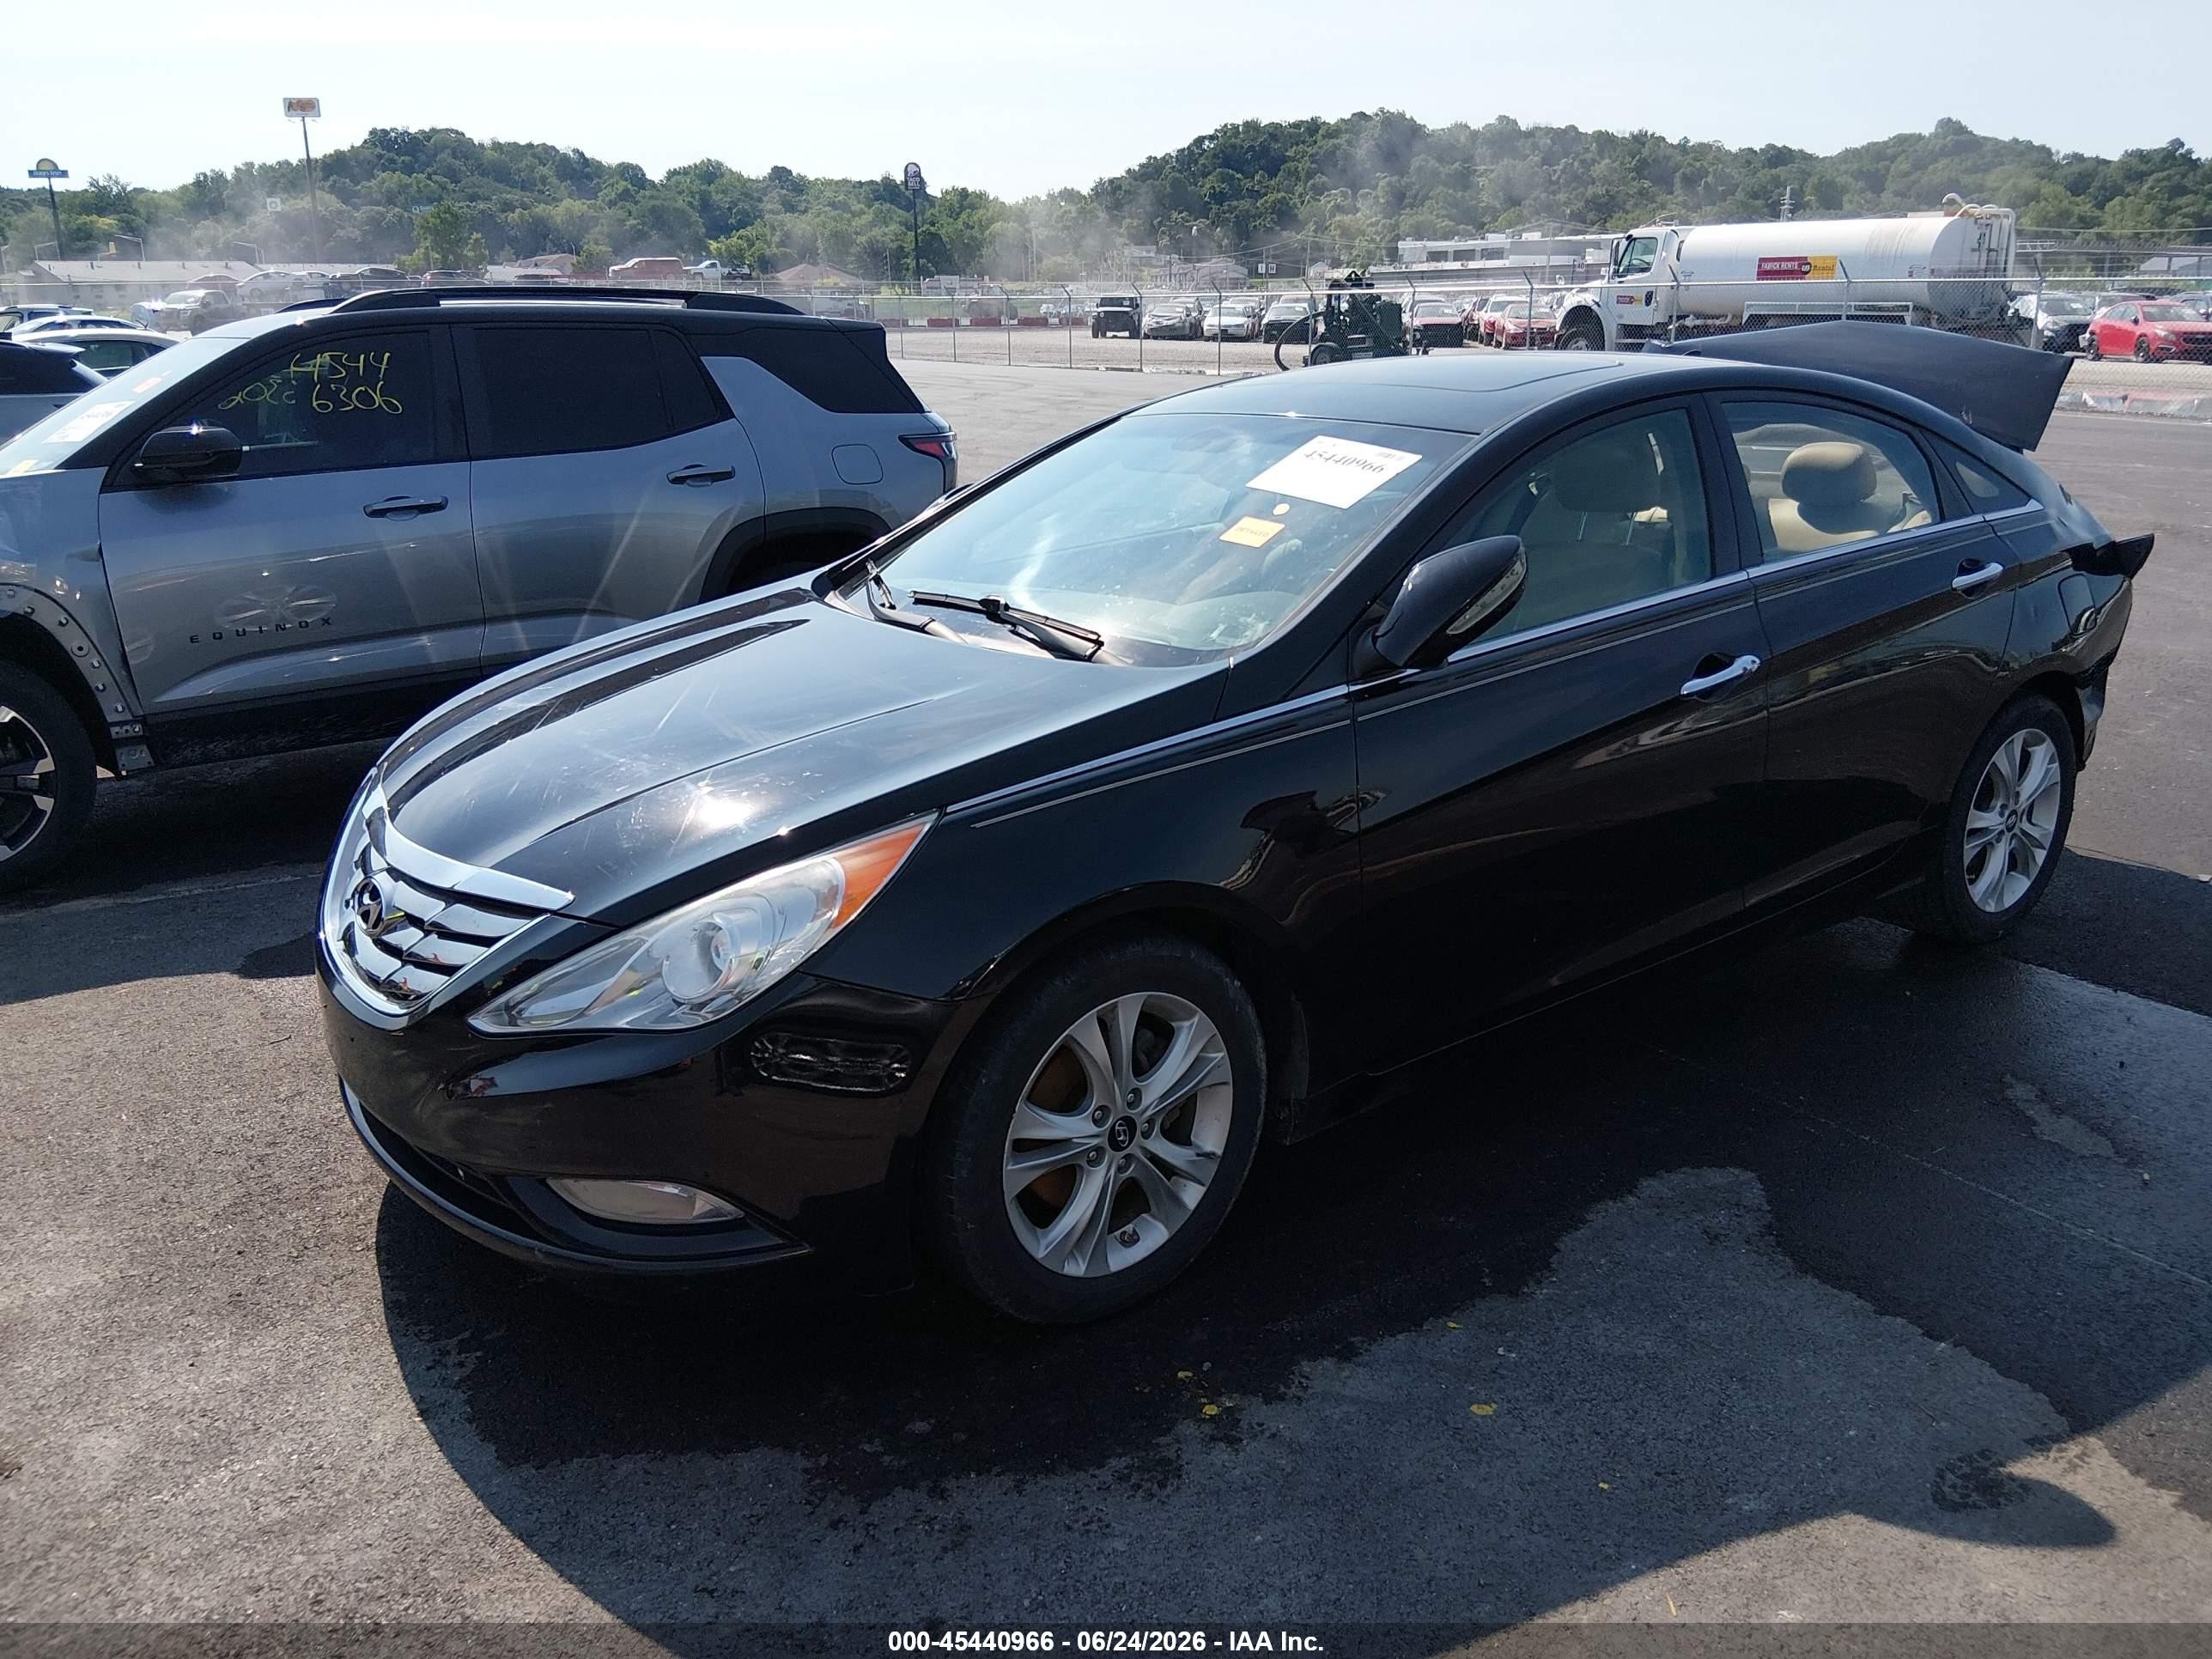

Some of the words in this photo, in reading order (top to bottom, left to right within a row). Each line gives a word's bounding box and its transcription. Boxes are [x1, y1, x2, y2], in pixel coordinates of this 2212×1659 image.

[282, 351, 391, 383] 4544
[312, 380, 403, 414] 6306
[189, 617, 332, 644] EQUINOX
